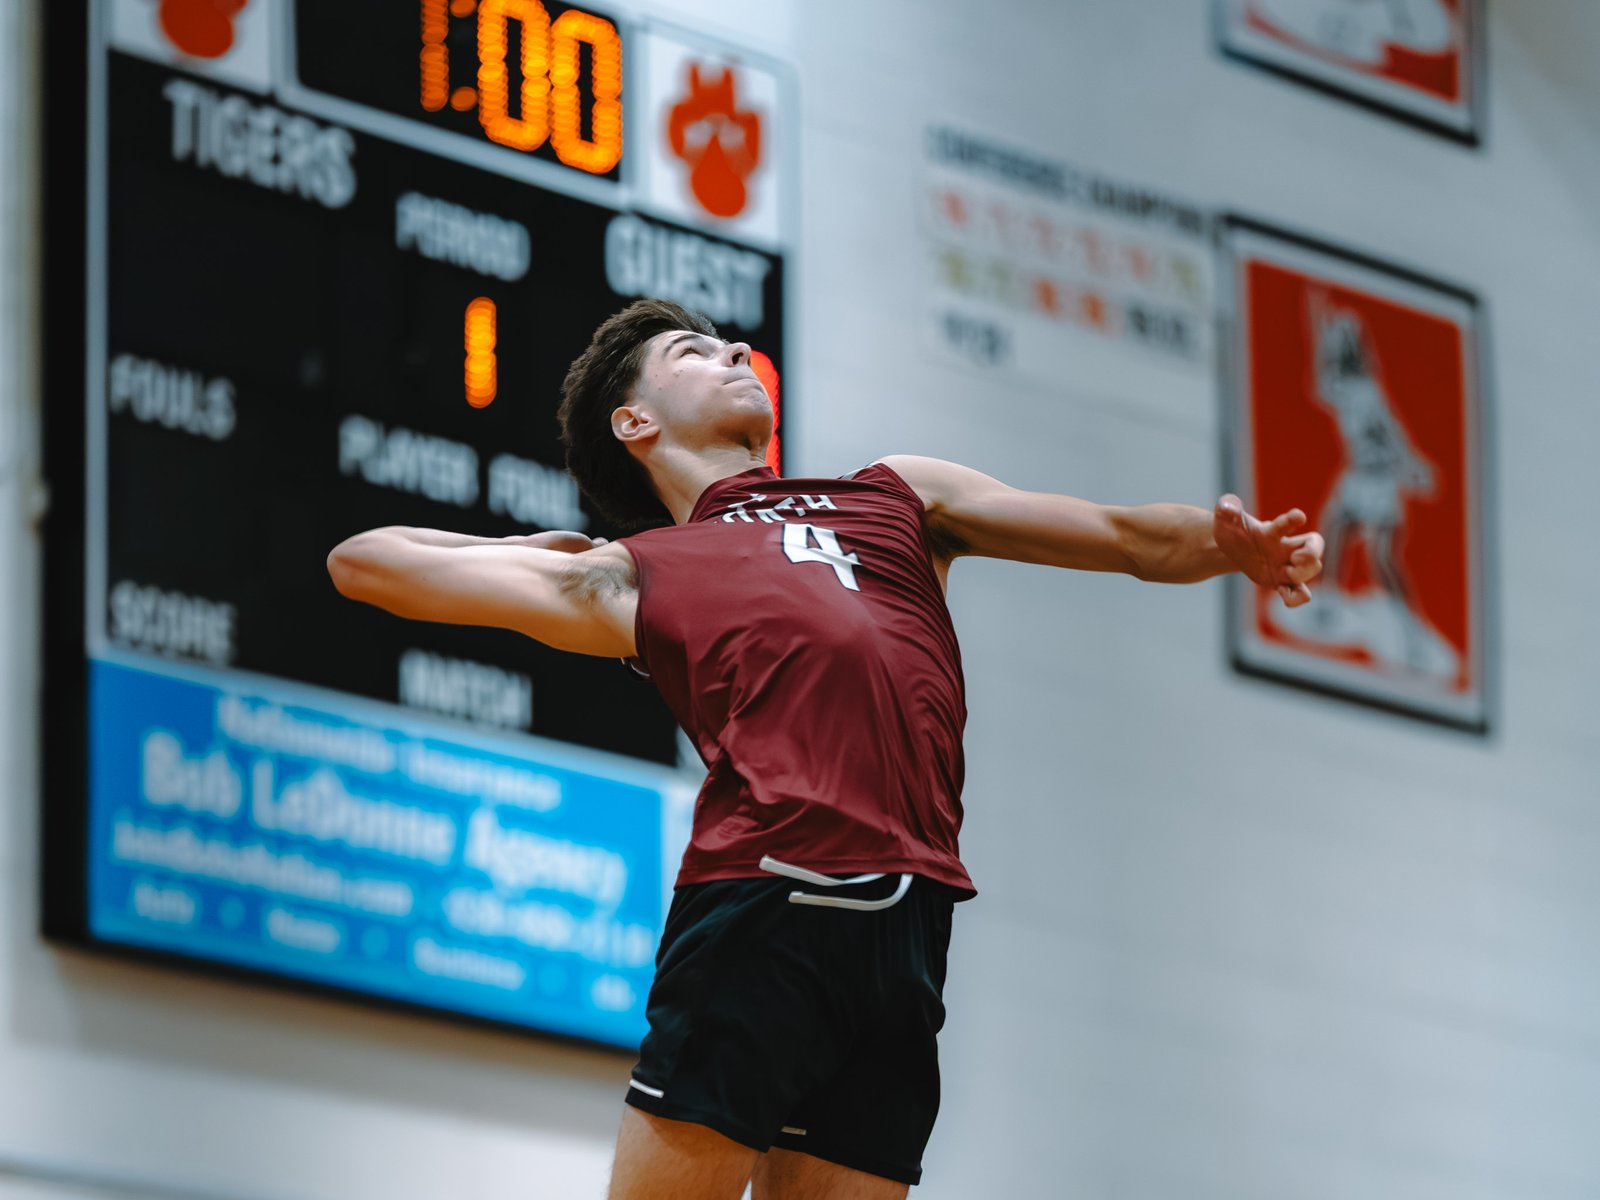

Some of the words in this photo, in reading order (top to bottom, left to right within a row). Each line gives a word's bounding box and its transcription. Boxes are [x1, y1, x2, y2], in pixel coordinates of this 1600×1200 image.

[163, 77, 357, 208] TIGERS
[394, 191, 531, 282] PERIOD
[604, 214, 773, 331] GUEST
[110, 352, 237, 441] FOULS
[464, 296, 497, 408] 1
[338, 414, 480, 508] PLAYER
[781, 522, 863, 592] 4
[143, 730, 243, 818] Bob
